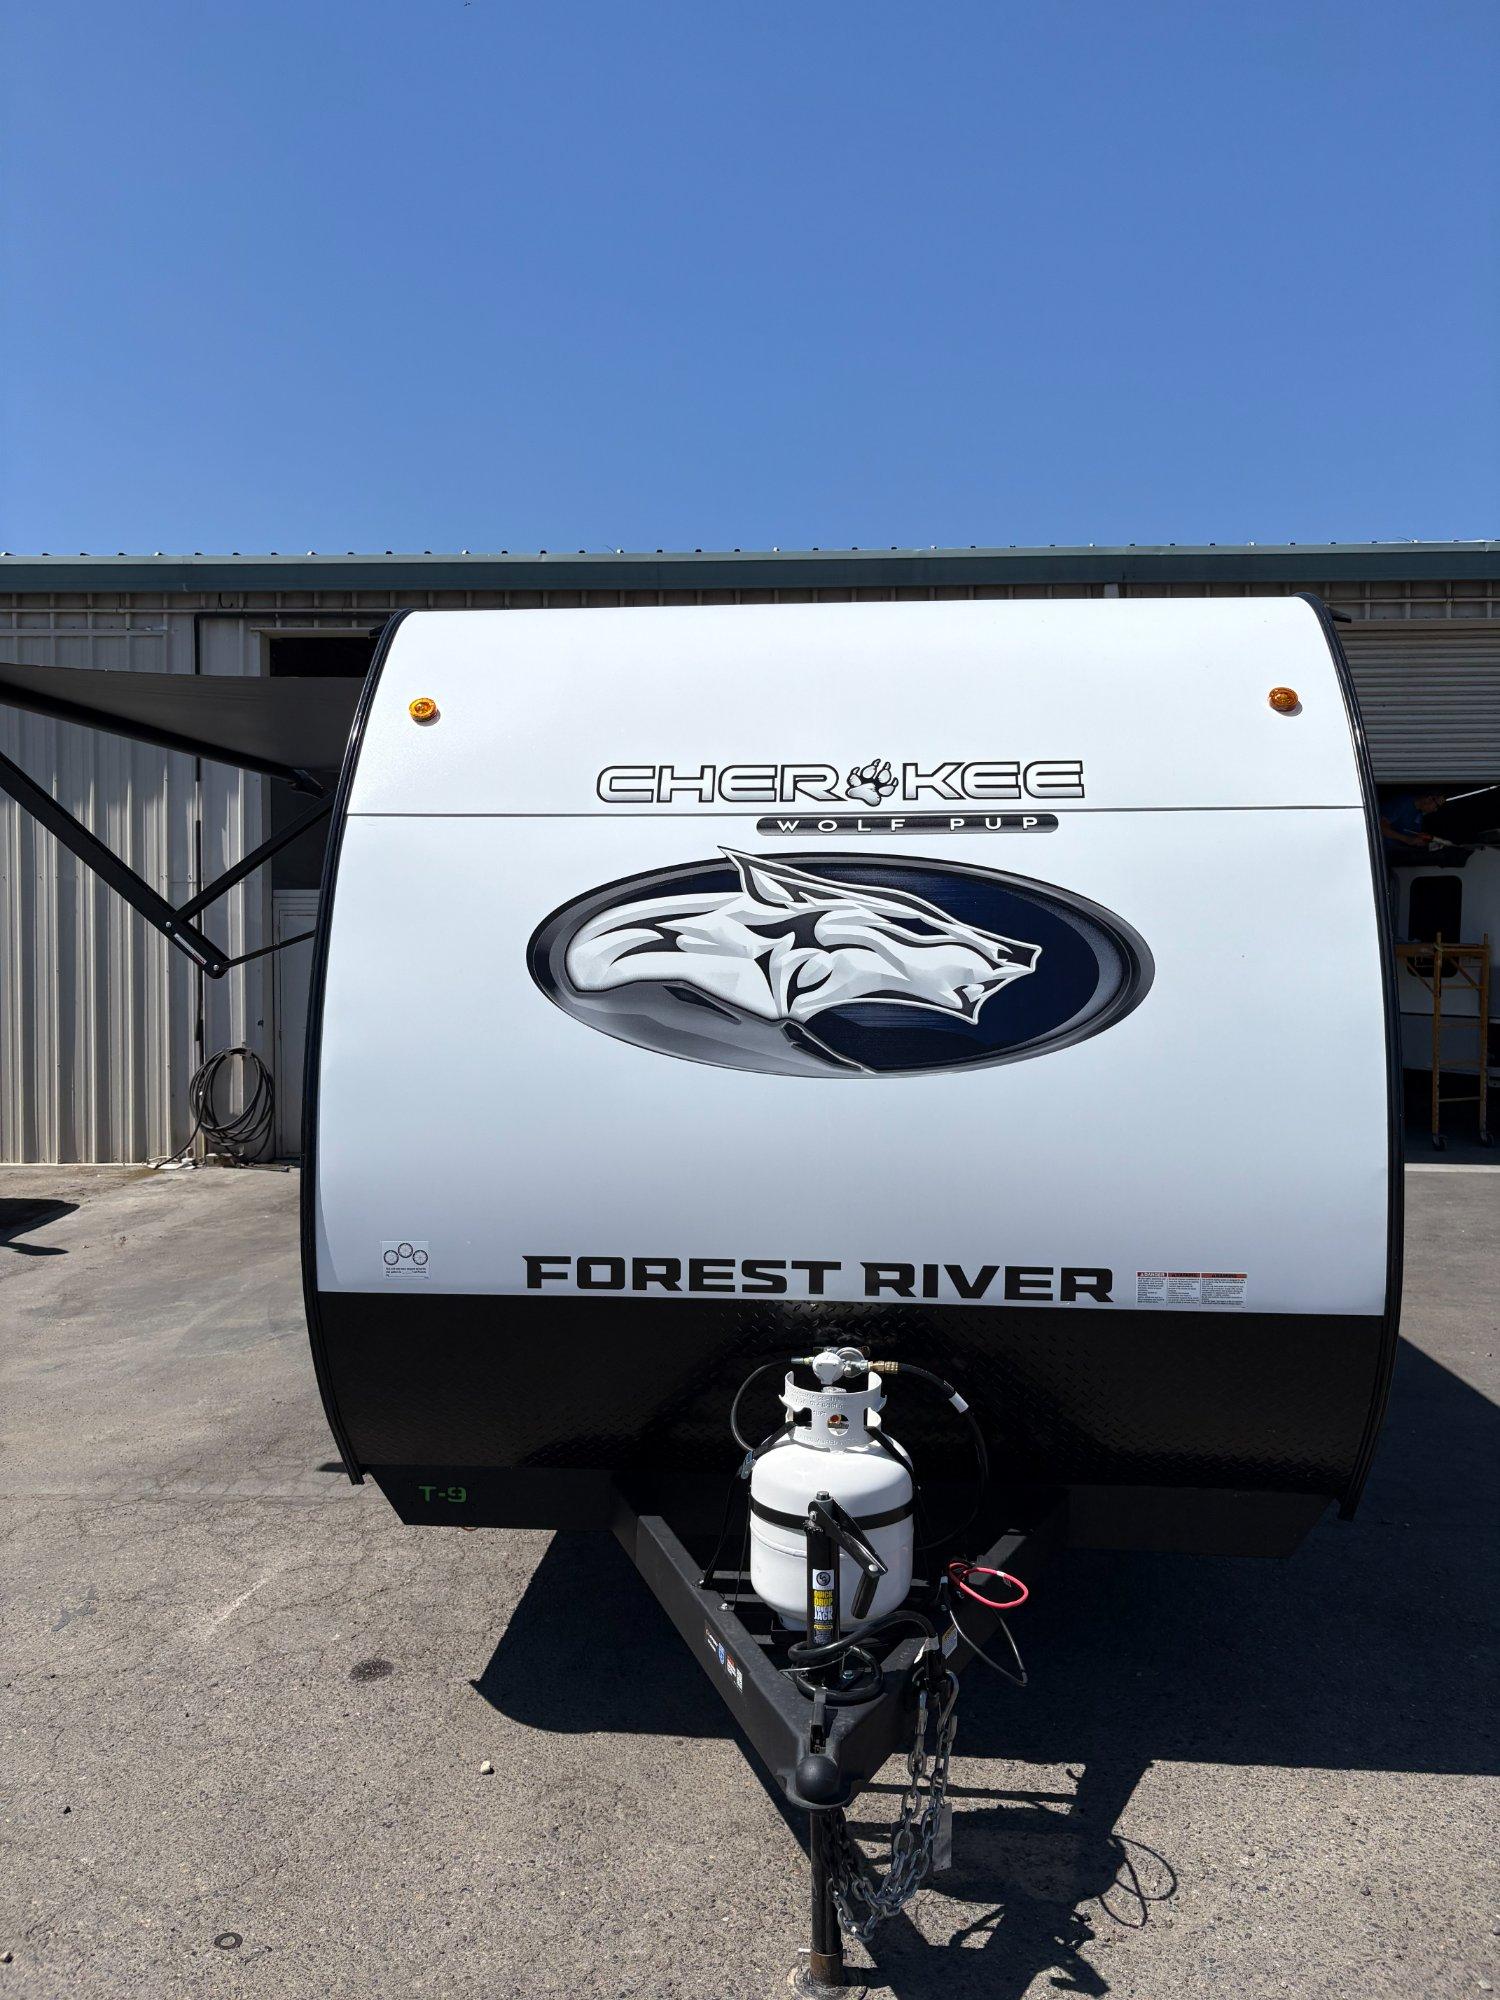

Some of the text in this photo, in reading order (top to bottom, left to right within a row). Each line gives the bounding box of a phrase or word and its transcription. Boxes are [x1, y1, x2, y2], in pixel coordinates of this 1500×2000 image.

[777, 816, 1038, 833] WOLF PUP
[521, 1255, 841, 1295] FOREST
[860, 1262, 1114, 1303] RIVER
[419, 1486, 467, 1503] T-9
[814, 1612, 833, 1621] JACK
